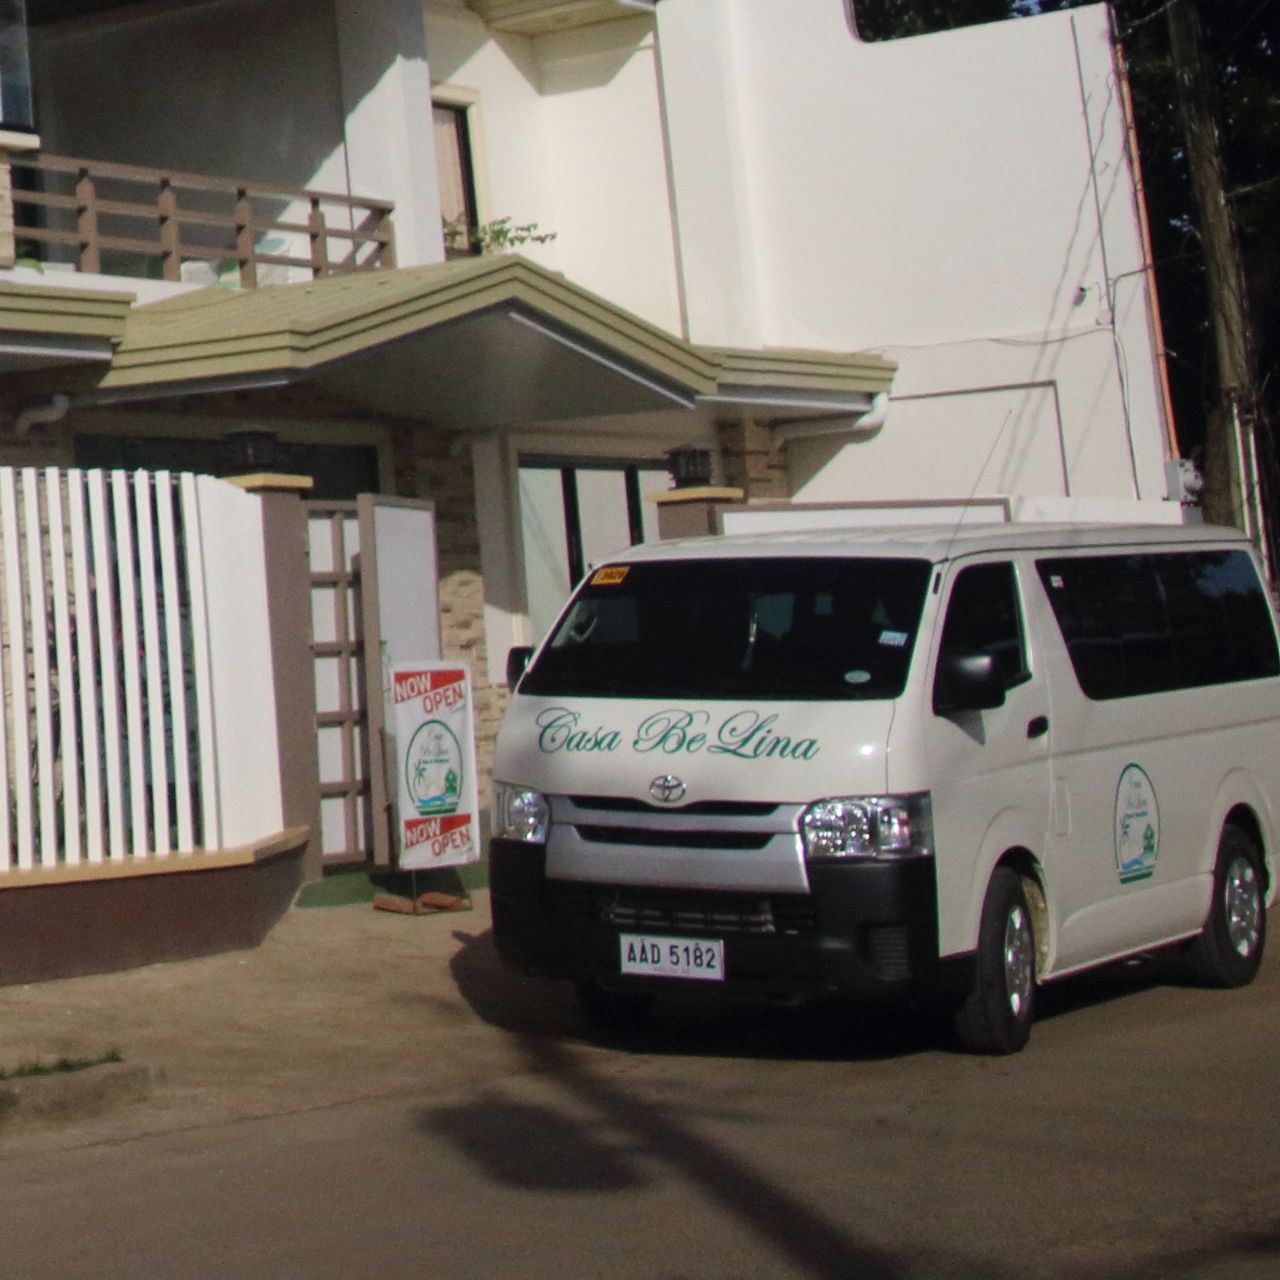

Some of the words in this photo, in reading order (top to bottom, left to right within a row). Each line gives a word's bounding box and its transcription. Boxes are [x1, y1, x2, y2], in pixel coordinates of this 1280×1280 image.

[395, 672, 431, 704] NOW
[423, 683, 464, 714] OPEN
[536, 707, 622, 753] Casa
[405, 817, 441, 849] NOW
[431, 827, 470, 857] OPEN
[627, 942, 661, 964] AAD
[669, 945, 716, 969] 5182
